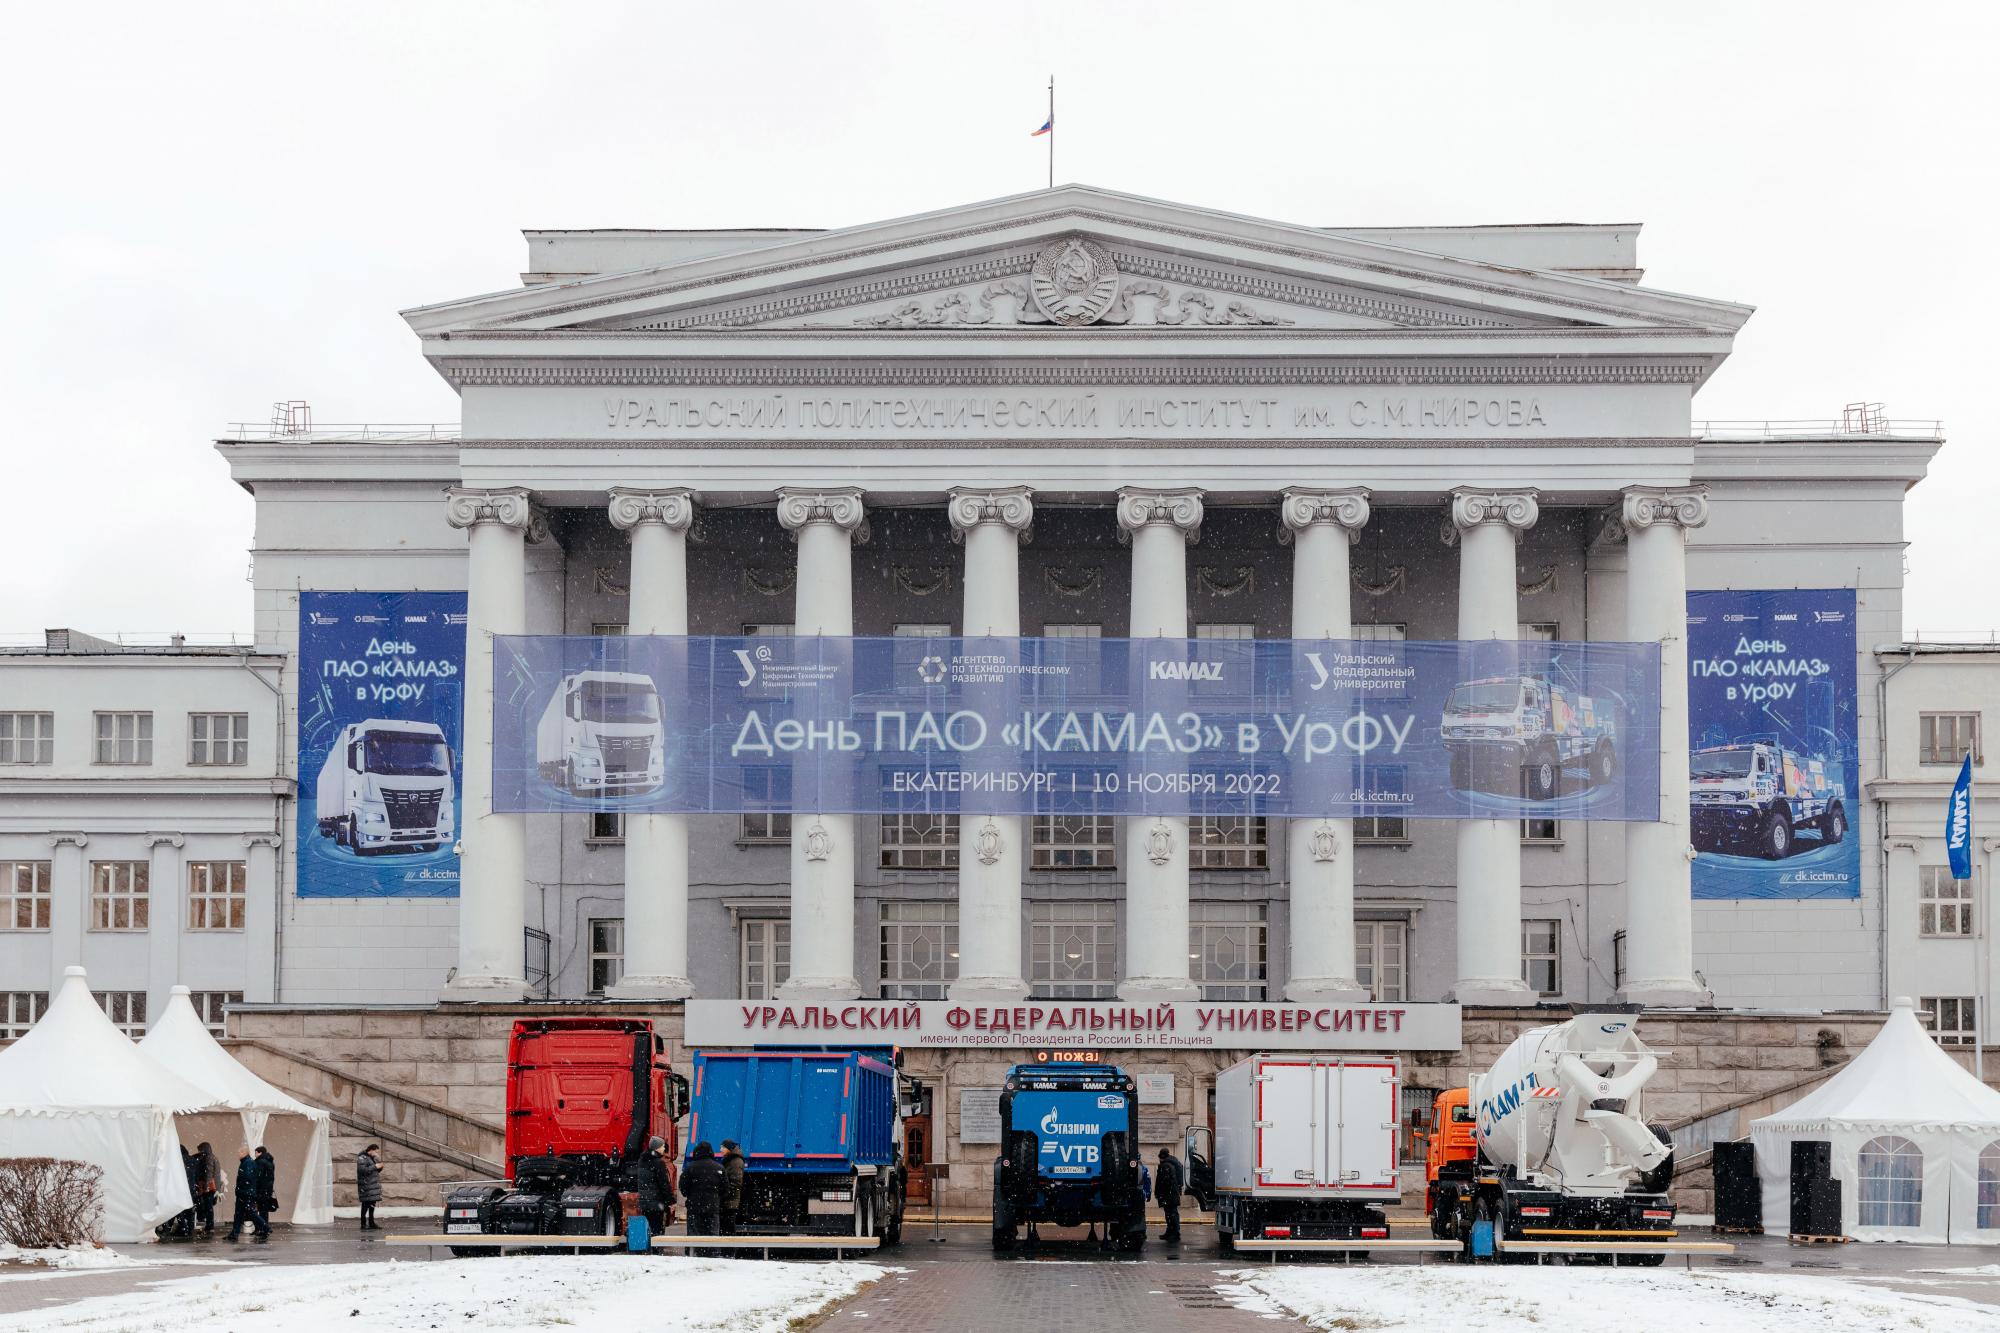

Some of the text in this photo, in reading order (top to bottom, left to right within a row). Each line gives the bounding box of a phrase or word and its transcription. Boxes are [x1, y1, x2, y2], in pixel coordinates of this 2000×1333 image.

[606, 395, 787, 428] УРАЛЬСКИЙ
[1118, 399, 1278, 428] ИНСТИТУТ
[405, 615, 428, 623] KAMAZ
[365, 637, 417, 657] День
[1734, 636, 1786, 656] День
[952, 656, 1006, 664] АГЕНТСТВО
[1333, 653, 1395, 665] Уральский
[1693, 658, 1830, 677] ПАО «КАМАЗ»
[323, 660, 458, 677] ПАО «КАМАЗ»
[952, 665, 1070, 674] ПО ТЕХНОЛОГИЧЕСКОМУ
[1150, 661, 1223, 681] KAMAZ
[1332, 666, 1415, 678] федеральный
[952, 674, 1004, 683] РАЗВИТИЮ
[1333, 679, 1407, 690] университет
[356, 682, 425, 704] в УрФУ
[1727, 681, 1797, 703] в УрФУ
[731, 710, 1416, 763] День ПАО «КАМАЗ» в УрФУ
[1093, 773, 1120, 793] 10
[1127, 773, 1216, 794] НОЯБРЯ
[1224, 774, 1281, 794] 2022
[1949, 788, 1967, 849] KAMAZ
[742, 1002, 1406, 1032] УРАЛЬСКИЙ ФЕДЕРАЛЬНЫЙ УНИВЕРСИТЕТ
[920, 1035, 958, 1043] имени
[961, 1035, 1009, 1046] первого
[1012, 1033, 1084, 1046] Президента
[1088, 1034, 1131, 1044] России
[1033, 1082, 1058, 1090] KAMAZ
[1083, 1082, 1108, 1090] KAMAZ
[1058, 1124, 1099, 1135] ГАЗПРОМ
[1060, 1145, 1099, 1163] VTB
